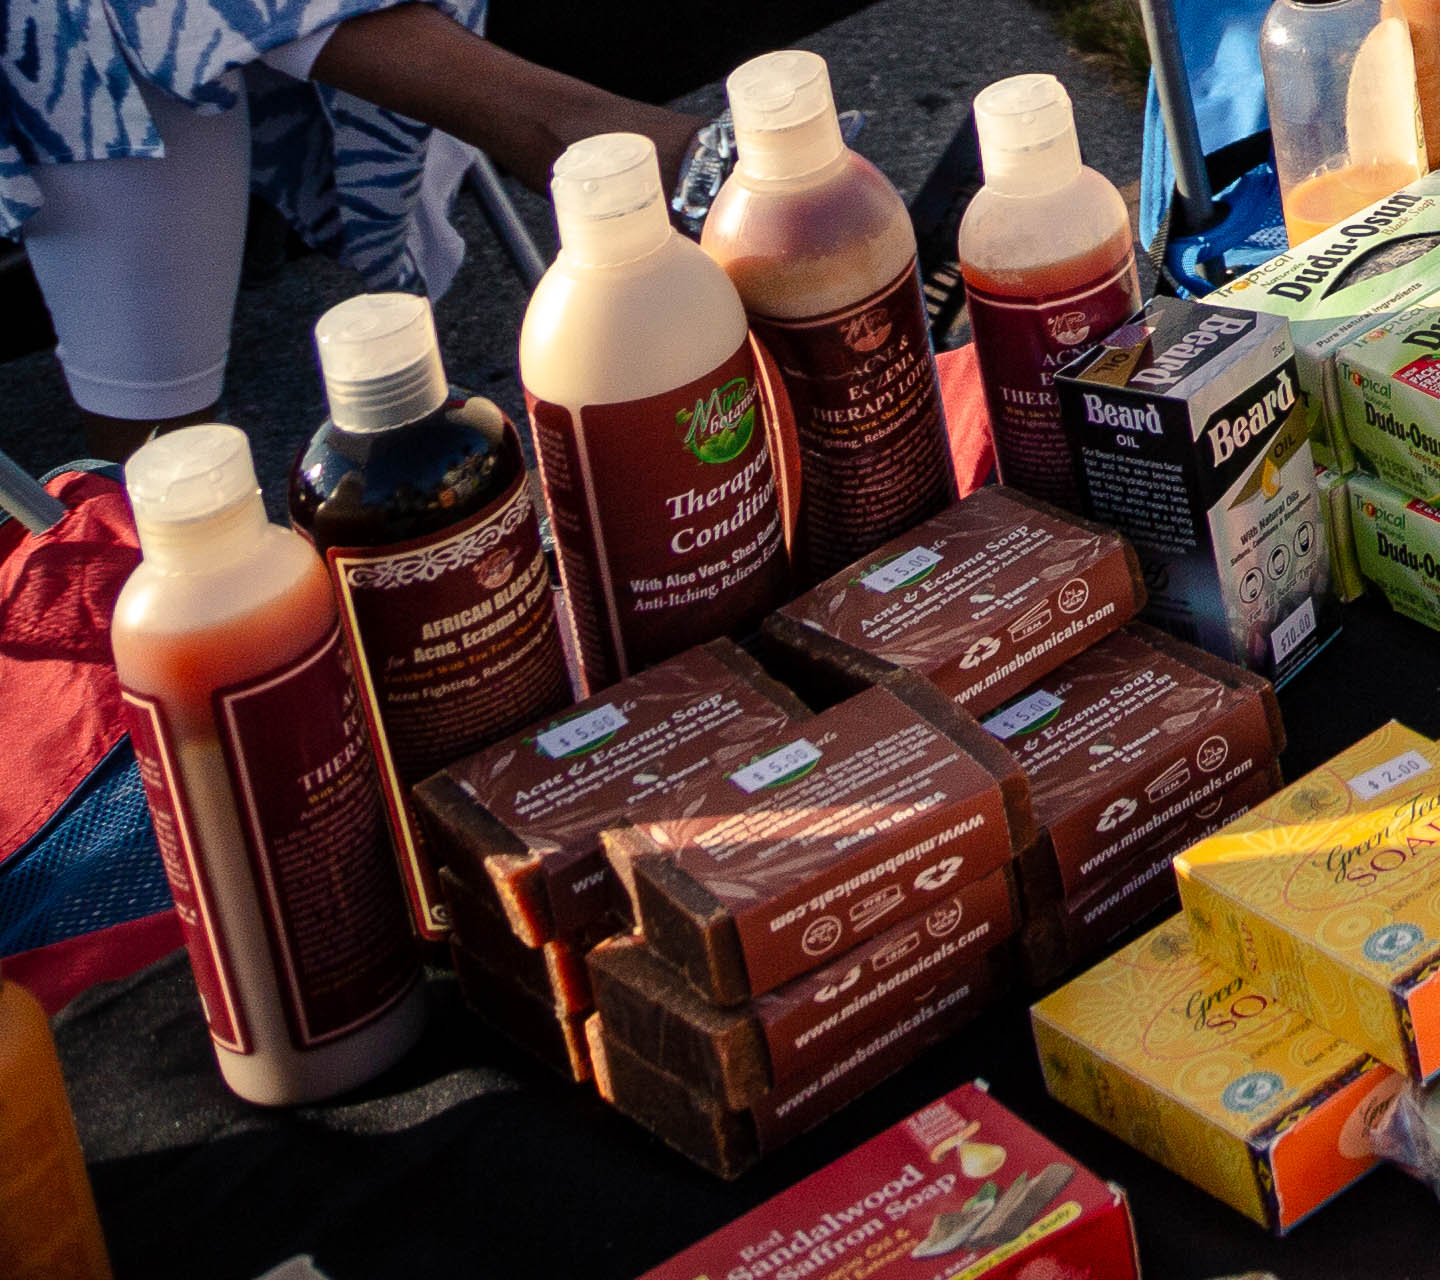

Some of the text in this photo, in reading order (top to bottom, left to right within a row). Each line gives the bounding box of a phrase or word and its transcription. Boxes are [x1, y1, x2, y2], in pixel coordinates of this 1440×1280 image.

[1267, 191, 1422, 303] Dudu-Osun
[1315, 280, 1423, 348] Pure Natural Ingredients
[1082, 392, 1163, 436] Beard
[1207, 370, 1295, 468] Beard
[1115, 434, 1140, 449] OIL
[1273, 432, 1298, 460] OIL
[630, 548, 758, 593] With Aloe Vera, Shea
[861, 524, 1030, 632] Acne & Eczema Soap
[895, 554, 931, 577] 5.00
[634, 584, 719, 612] Anti-Itching,
[1386, 756, 1421, 786] 2.00
[1312, 818, 1395, 884] Green
[885, 1172, 958, 1223] Soap
